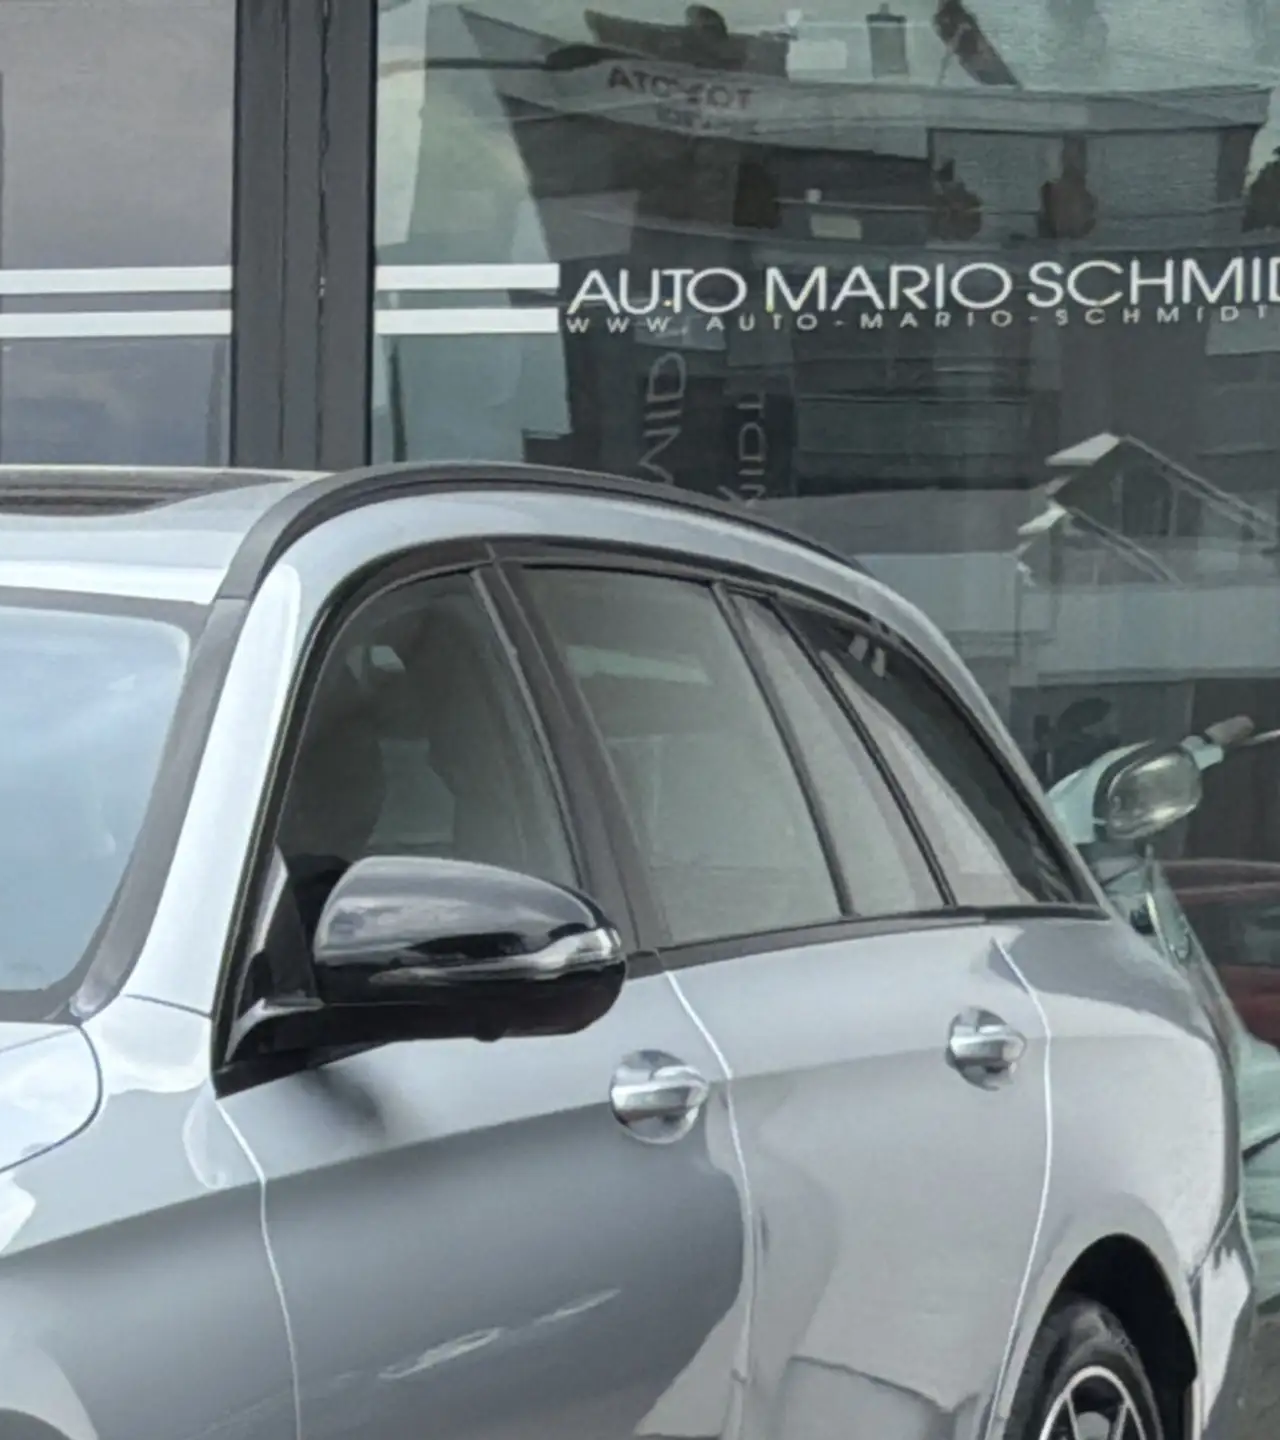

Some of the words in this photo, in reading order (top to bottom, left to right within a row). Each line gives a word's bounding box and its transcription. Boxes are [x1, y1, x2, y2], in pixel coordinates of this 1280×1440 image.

[566, 267, 747, 315] AUTO
[765, 262, 1013, 312] MARIO
[1027, 256, 1280, 308] SCHMI
